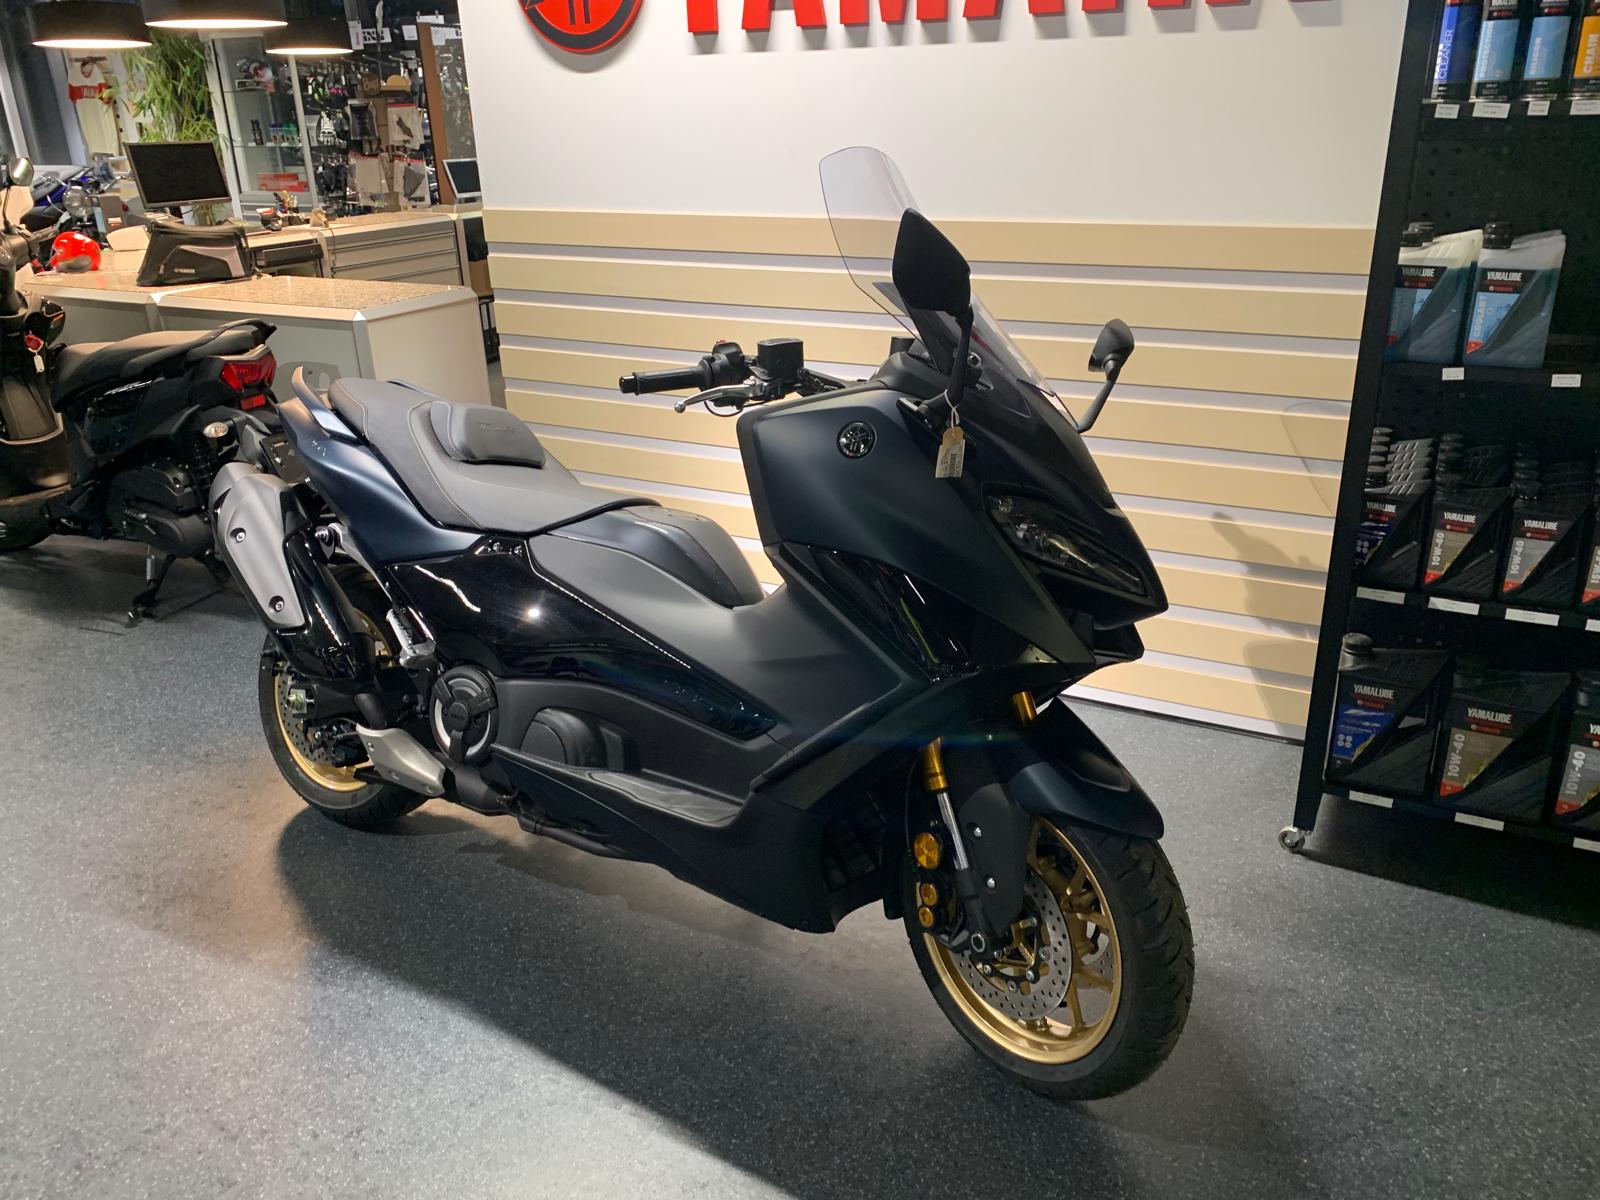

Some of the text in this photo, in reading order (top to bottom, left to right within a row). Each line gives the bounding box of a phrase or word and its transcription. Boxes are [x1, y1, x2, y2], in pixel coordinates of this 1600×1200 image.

[1438, 28, 1454, 79] CLEANER
[1583, 32, 1600, 74] CHAIN
[1401, 267, 1436, 278] YAMALUBE
[1487, 270, 1523, 281] YAMALUBE
[1473, 295, 1488, 338] COOLANT
[1366, 501, 1397, 513] YAMALUBE
[1443, 511, 1477, 524] YAMALUBE
[1523, 519, 1559, 531] YAMALUBE
[1431, 532, 1445, 566] 10W-40
[1510, 540, 1525, 574] 10W-40
[1353, 683, 1395, 700] YAMALUBE
[1467, 707, 1512, 724] YAMALUBE
[1447, 733, 1466, 777] 10W-40
[1564, 751, 1586, 796] 10W-40
